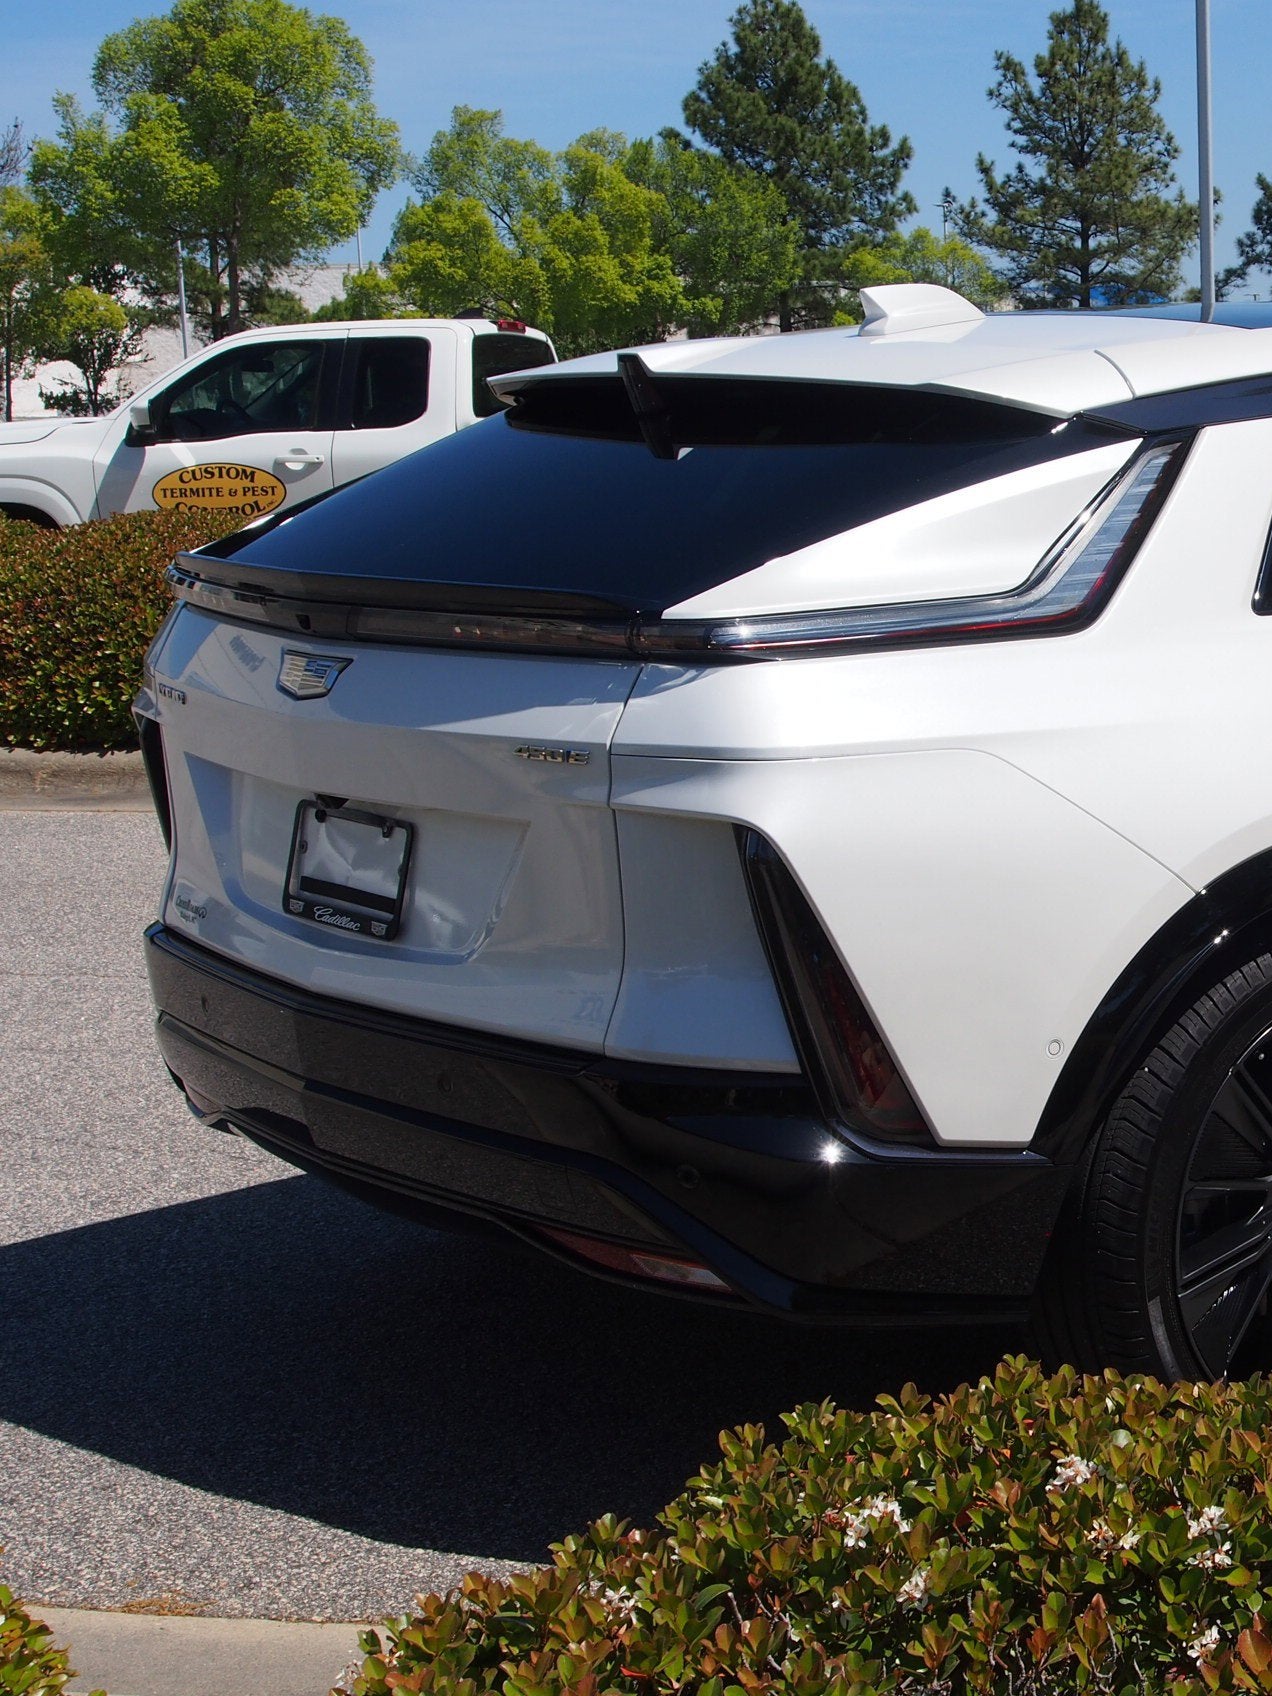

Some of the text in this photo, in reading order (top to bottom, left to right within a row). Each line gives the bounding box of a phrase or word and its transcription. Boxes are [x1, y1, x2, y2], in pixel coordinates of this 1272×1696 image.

[178, 466, 256, 483] CUSTOM
[160, 485, 278, 499] TERMITE & PEST
[313, 905, 361, 931] Cadillac
